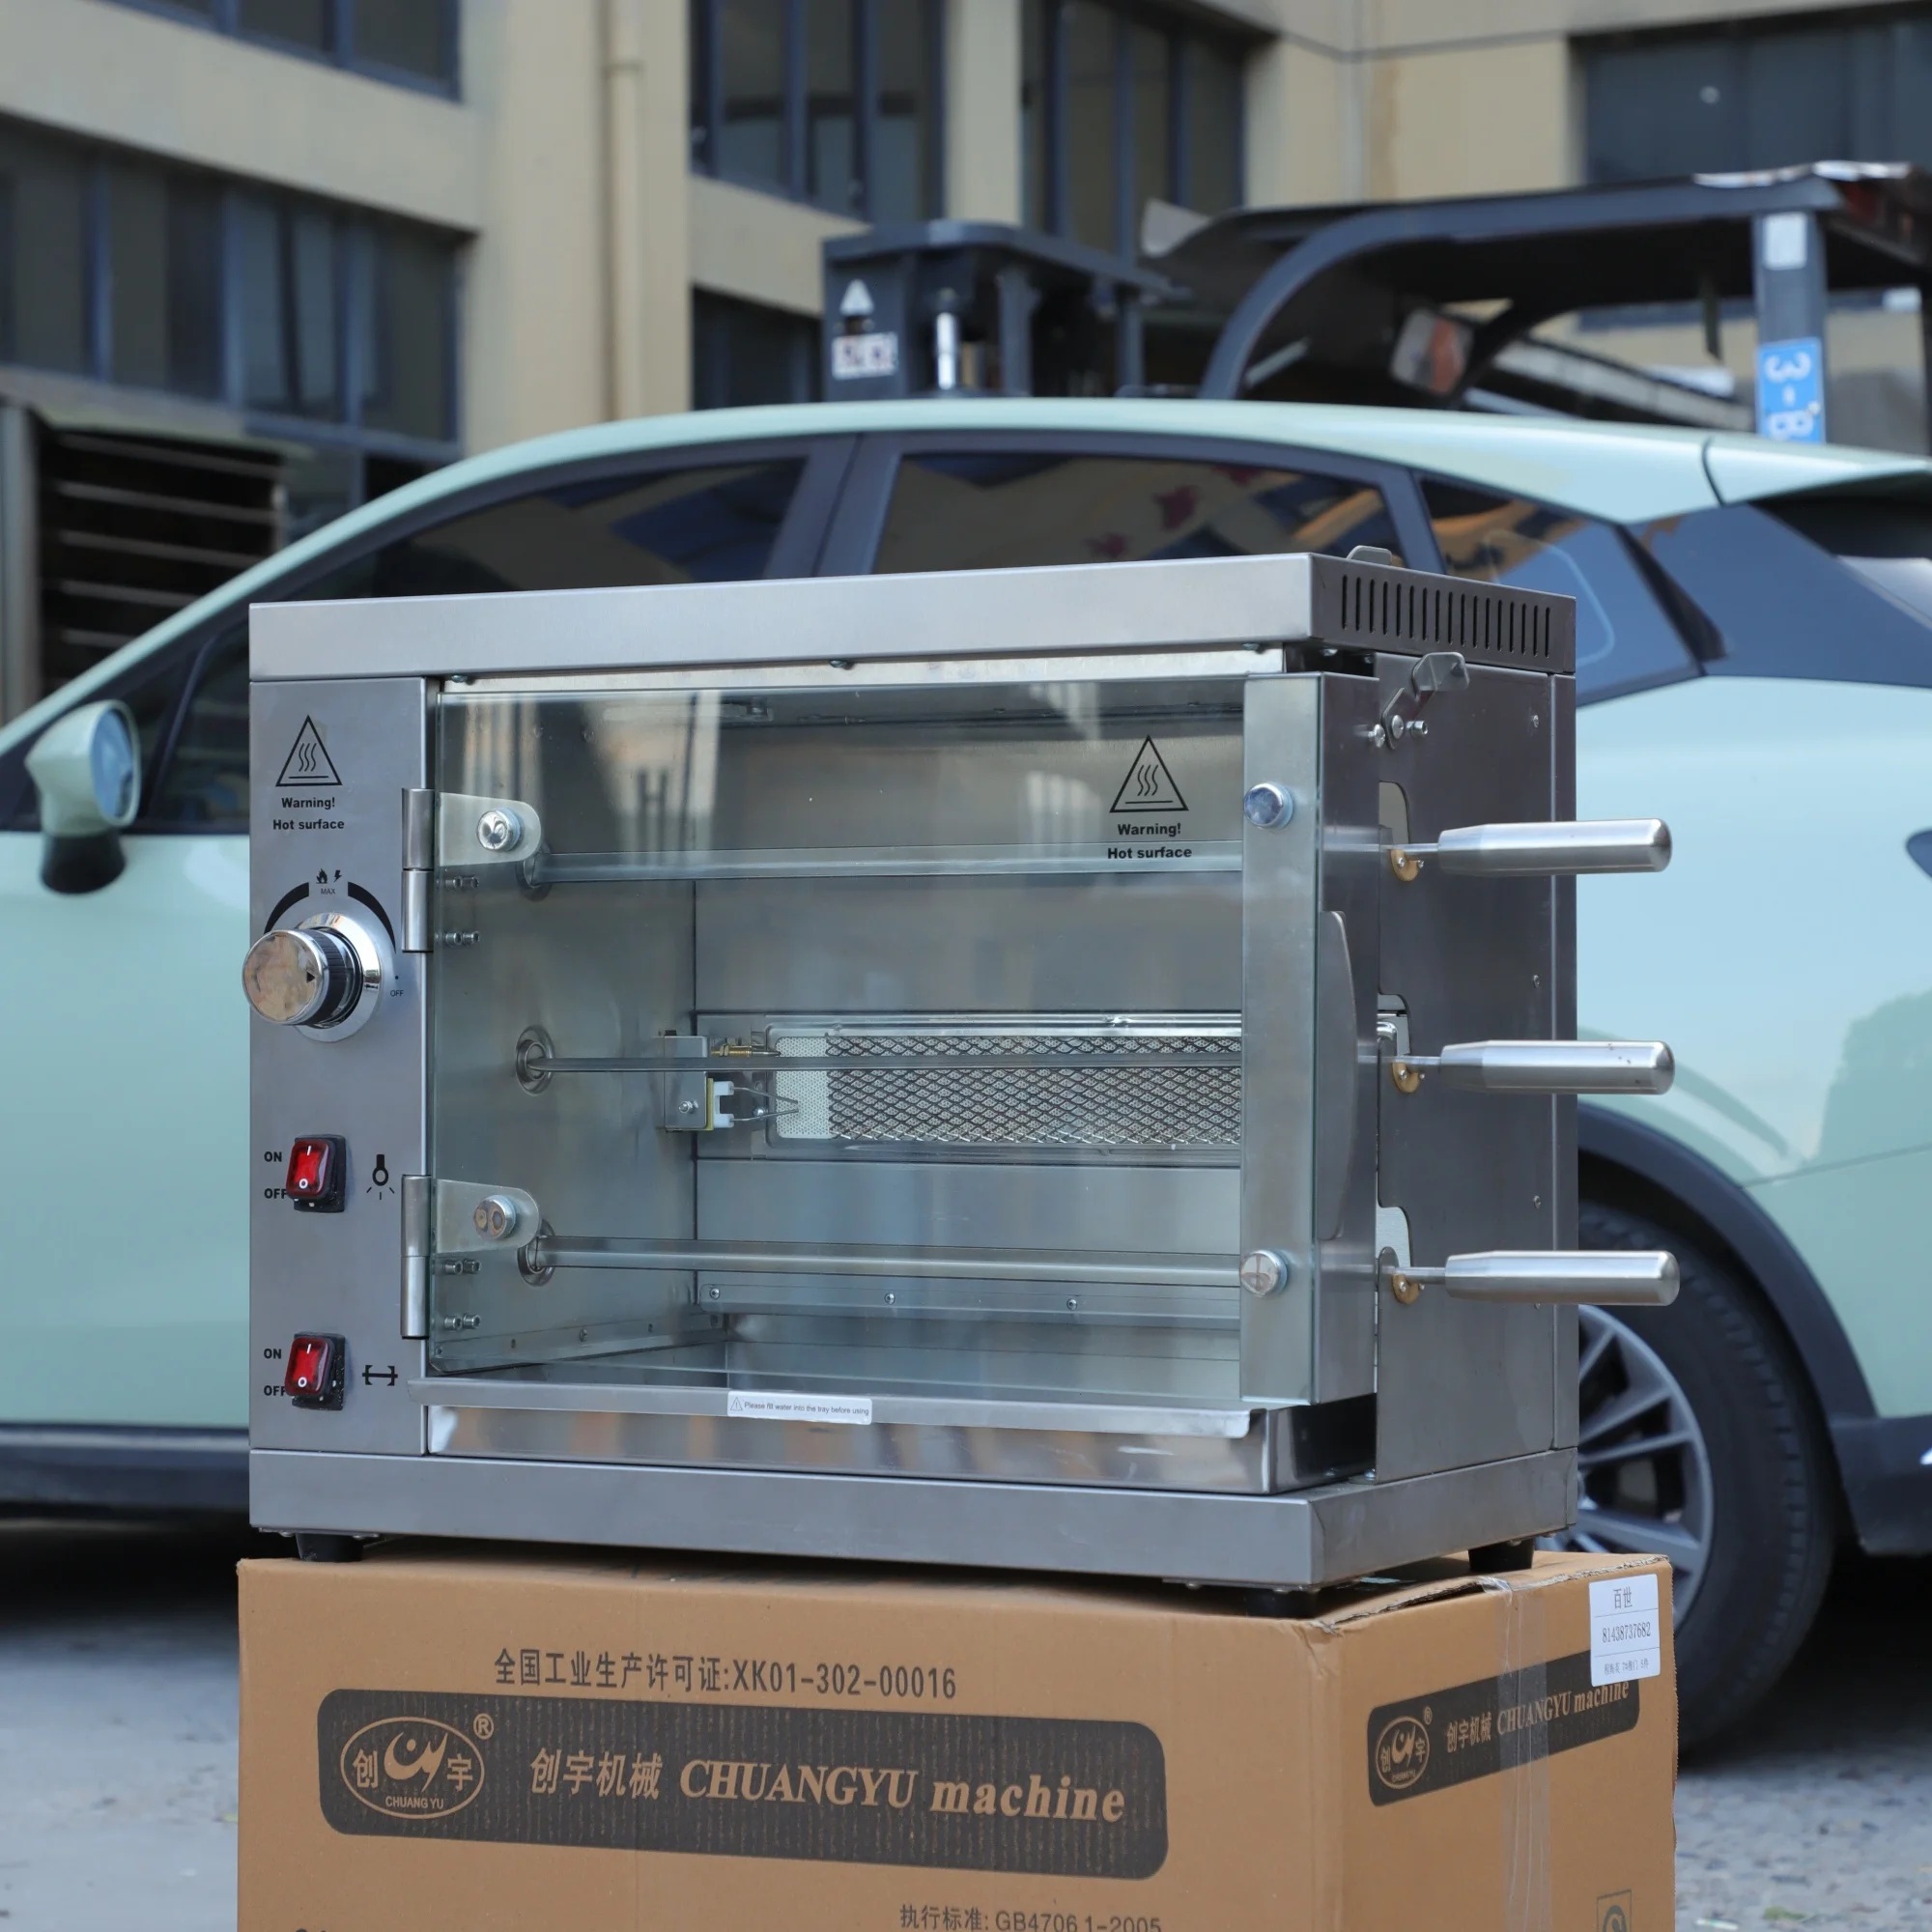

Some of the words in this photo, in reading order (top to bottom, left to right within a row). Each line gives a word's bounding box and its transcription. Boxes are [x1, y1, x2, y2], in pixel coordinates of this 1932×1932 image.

[281, 797, 336, 810] Warning!
[272, 819, 295, 830] Hot
[298, 818, 345, 830] surface
[1118, 823, 1181, 837] Warning!
[1107, 847, 1132, 859] Hot
[1137, 846, 1193, 859] surface
[264, 1151, 283, 1162] ON
[263, 1348, 282, 1359] ON
[744, 1401, 765, 1409] Please
[817, 1406, 829, 1414] tray
[852, 1407, 869, 1416] using
[1613, 1586, 1634, 1609] 百世
[1602, 1621, 1652, 1643] 81438737682
[1497, 1691, 1572, 1735] CHUANGYU
[1574, 1681, 1630, 1714] machine
[353, 1748, 379, 1789] 创
[446, 1752, 473, 1792] 宇
[530, 1747, 663, 1800] 创宇机械
[680, 1759, 919, 1808] CHUANGYU
[929, 1774, 1125, 1823] machine
[384, 1795, 428, 1808] CHUANG
[430, 1797, 444, 1809] YU
